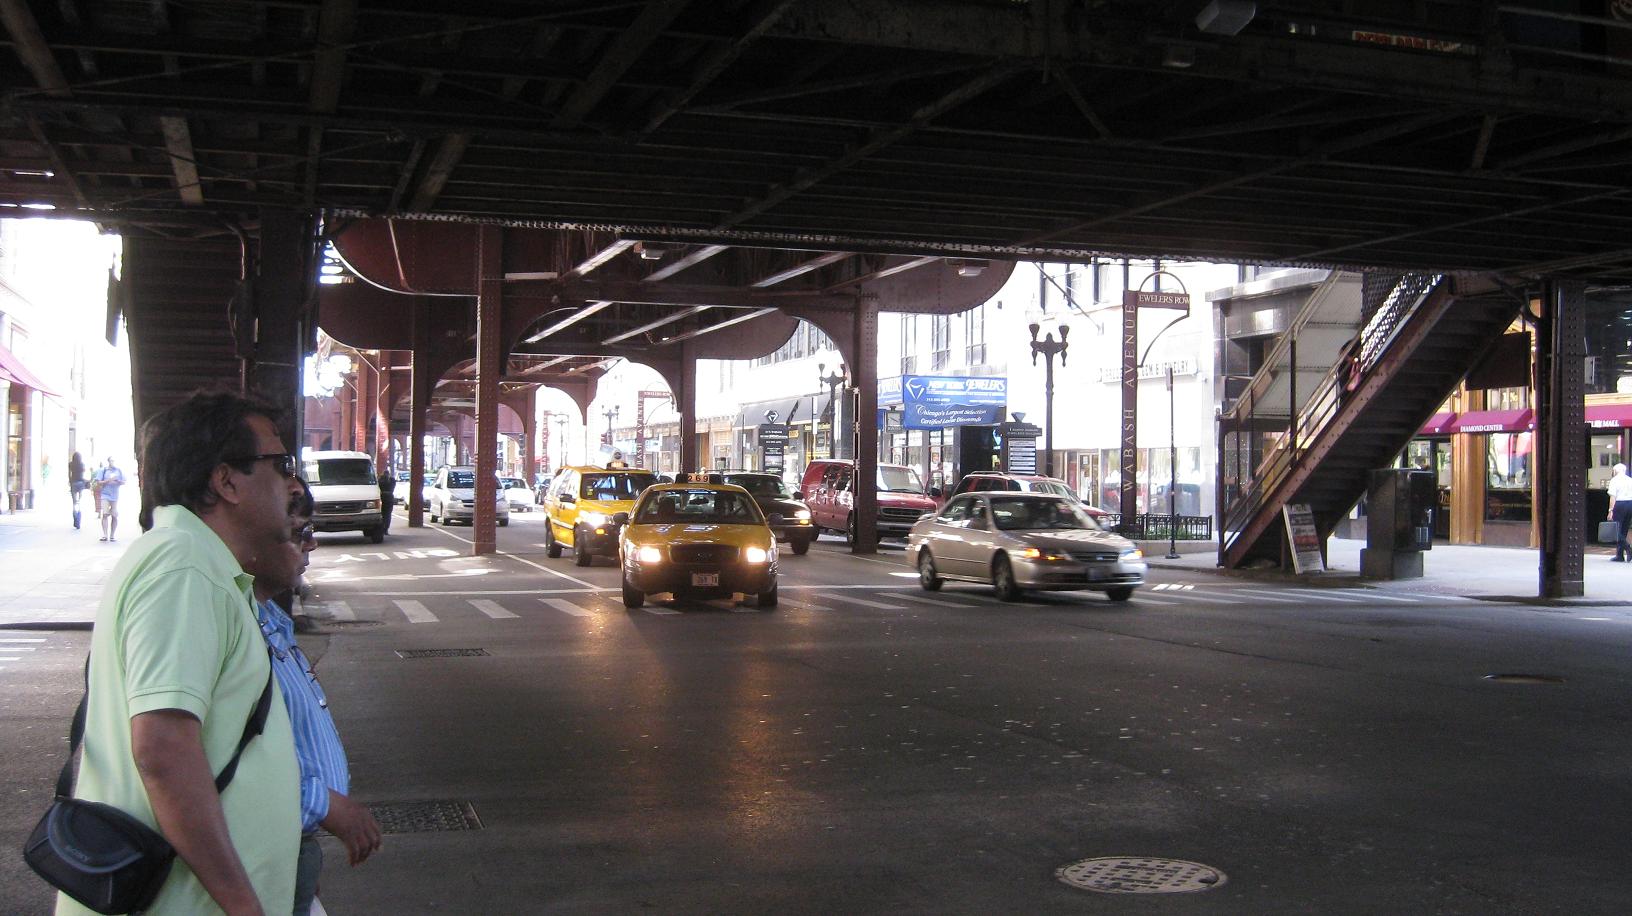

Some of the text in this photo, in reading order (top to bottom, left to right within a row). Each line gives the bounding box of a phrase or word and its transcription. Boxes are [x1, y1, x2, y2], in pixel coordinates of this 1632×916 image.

[1138, 294, 1190, 305] EWELERS ROW
[965, 378, 1005, 393] JEWELERS
[1123, 304, 1136, 492] WABASH AVENUE
[916, 404, 945, 417] Chicago's
[1460, 424, 1503, 433] DIAMOND CENTER
[1602, 420, 1619, 428] MALL
[334, 548, 460, 563] ONLY
